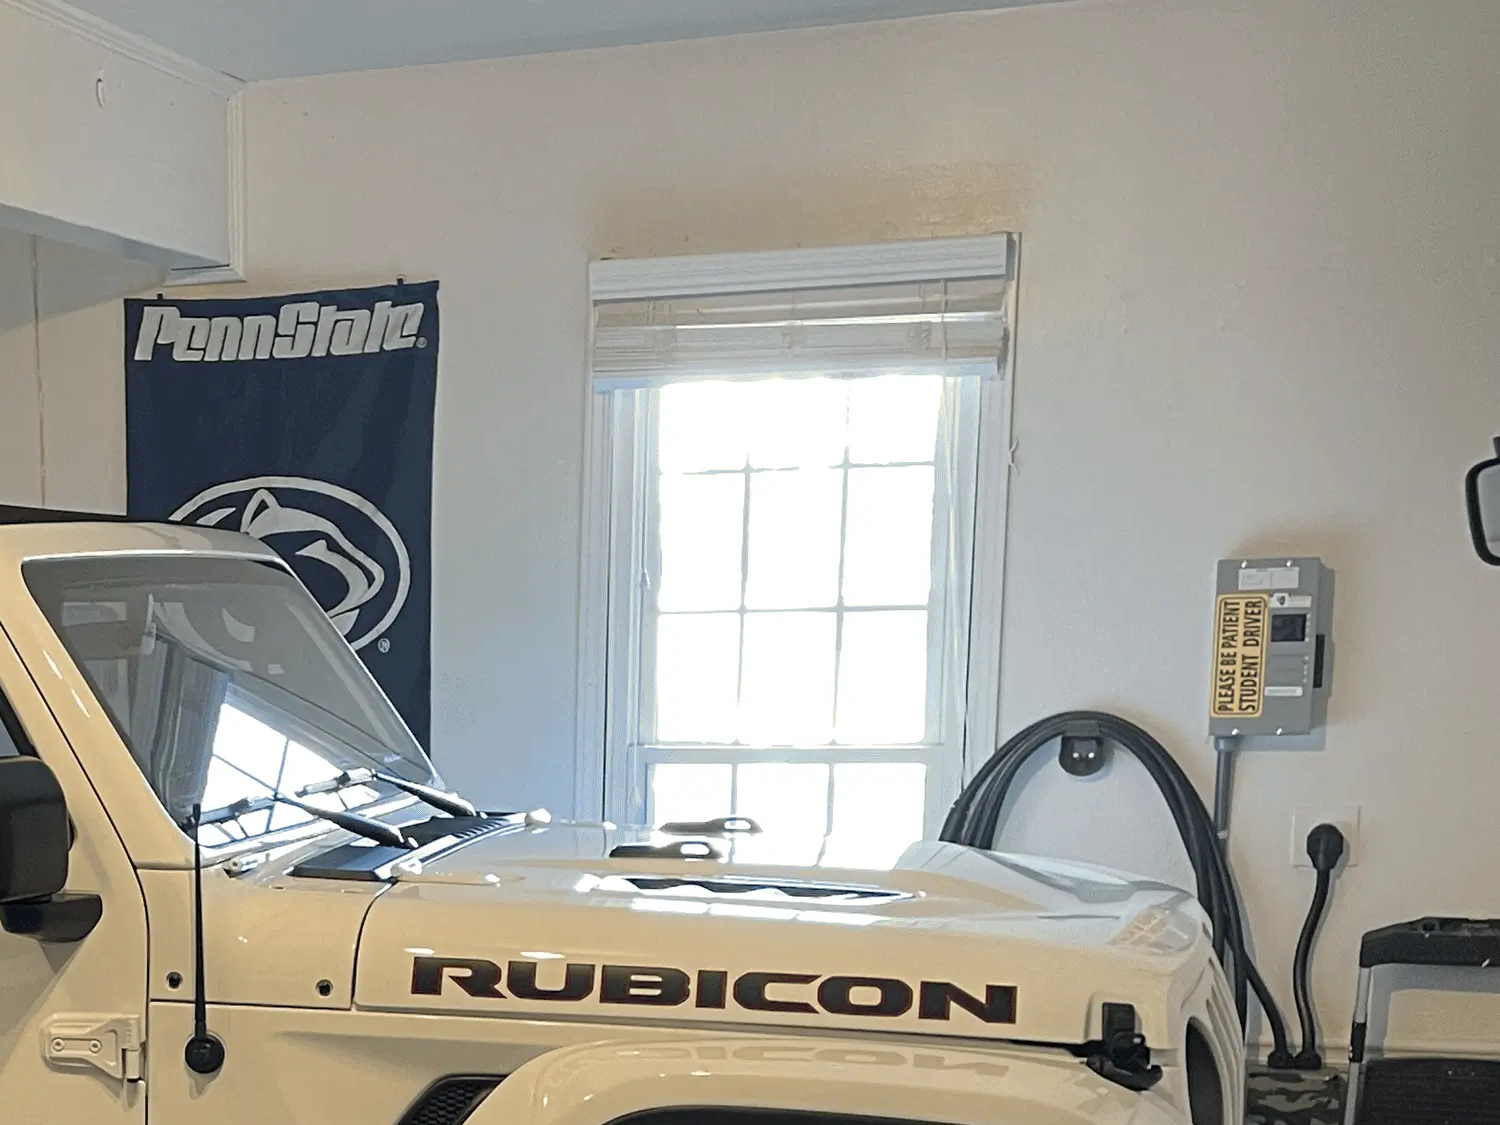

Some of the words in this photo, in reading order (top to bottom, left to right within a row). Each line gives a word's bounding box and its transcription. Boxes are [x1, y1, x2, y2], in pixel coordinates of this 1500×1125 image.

[1221, 600, 1240, 649] PATIENT
[1243, 600, 1263, 647] DRIVER
[1220, 651, 1237, 666] BE
[1217, 669, 1237, 712] PLEASE
[1238, 654, 1260, 712] STUDENT
[410, 956, 1018, 1024] RUBICON
